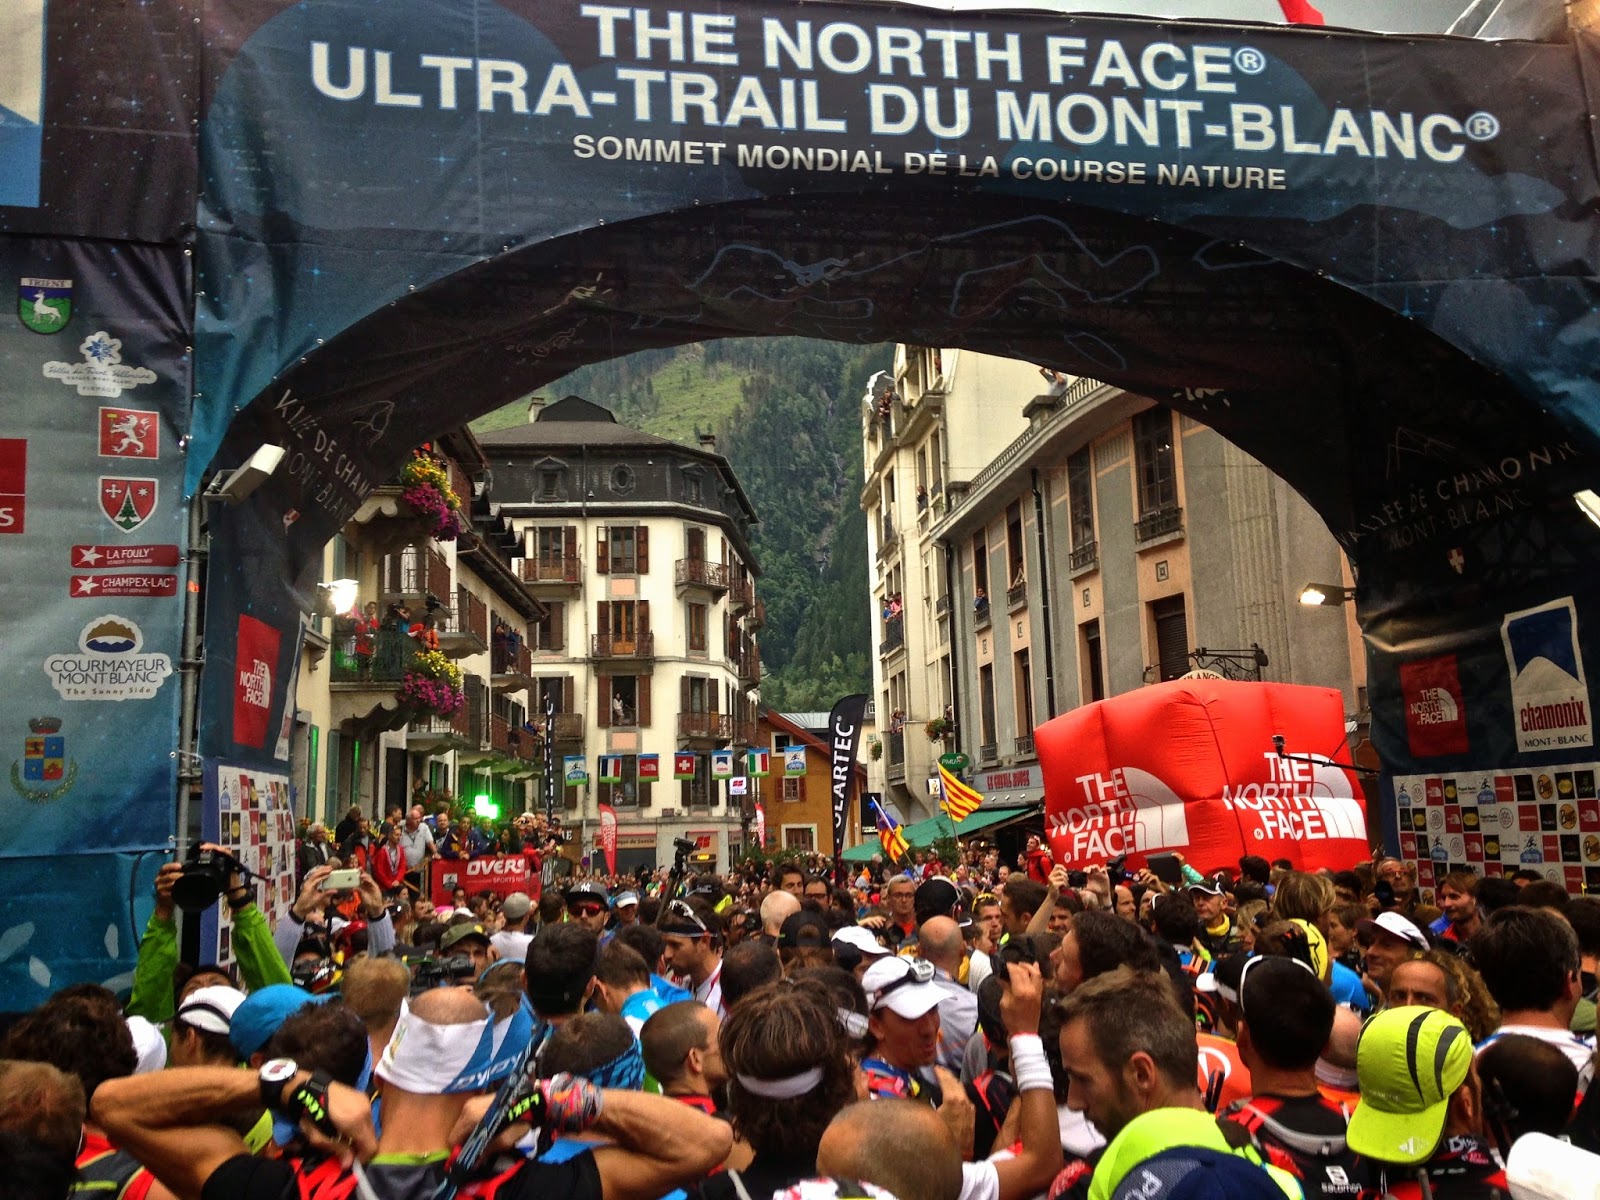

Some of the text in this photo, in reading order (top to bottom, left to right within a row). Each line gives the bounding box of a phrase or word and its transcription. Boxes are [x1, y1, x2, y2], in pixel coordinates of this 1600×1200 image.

[580, 5, 738, 67] THE
[763, 18, 1025, 82] NORTH
[310, 41, 848, 134] ULTRA-TRAIL
[870, 84, 971, 140] DU
[573, 134, 1286, 191] SOMMET MONDIAL DE LA COURSE NATURE
[106, 548, 149, 560] LA FOULY
[102, 577, 170, 588] CHAMPEX-LAC
[50, 659, 166, 673] COURMAYEUR
[58, 672, 157, 685] MONT BLANC
[253, 659, 266, 675] THE
[239, 670, 264, 690] NORTH
[245, 687, 263, 707] FACE
[1420, 688, 1439, 701] THE
[1411, 701, 1442, 716] NORTH
[1421, 712, 1443, 725] FACE
[1520, 697, 1588, 733] chamonix
[1264, 751, 1313, 782] THE
[1075, 767, 1128, 804] THE
[1221, 781, 1318, 811] NORTH
[1049, 796, 1136, 838] NORTH
[1258, 809, 1327, 841] FACE
[1073, 823, 1136, 862] FACE
